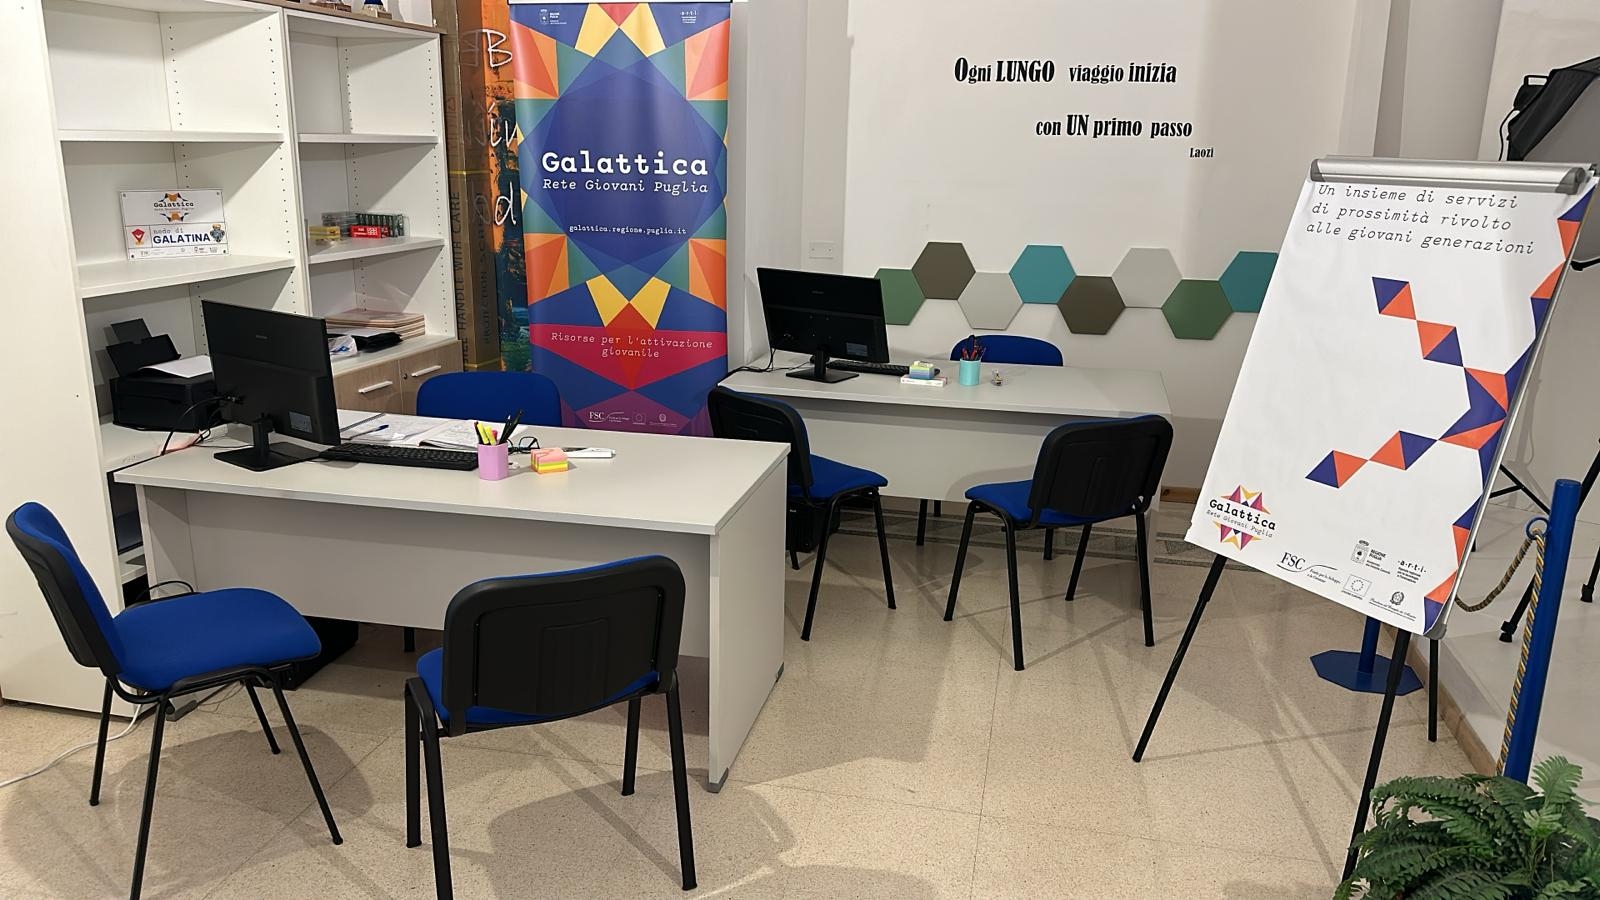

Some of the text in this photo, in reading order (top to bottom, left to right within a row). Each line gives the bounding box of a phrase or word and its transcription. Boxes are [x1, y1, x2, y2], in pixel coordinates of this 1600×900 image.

[954, 57, 1177, 84] Ogni LUNGO viaggio inizia
[1036, 114, 1193, 139] con UN primo passo
[542, 150, 708, 176] Galattica
[1190, 147, 1214, 158] Laozi
[543, 178, 708, 195] Rete Giovani Puglia
[1318, 185, 1518, 209] Un insieme di servizi
[451, 192, 461, 234] CARE
[1312, 202, 1511, 230] di prossimità rivolto
[153, 233, 211, 244] GALATINA
[569, 224, 687, 235] galattica.regione.puglia.it
[1306, 222, 1534, 255] alle giovani generazioni
[452, 241, 463, 273] WITH
[456, 278, 466, 331] HANDLE
[551, 332, 713, 349] Risorse per l'attivazione
[601, 347, 660, 358] giovanile
[589, 411, 604, 420] FSC
[1209, 499, 1276, 530] Galattica
[1280, 552, 1306, 570] FSC
